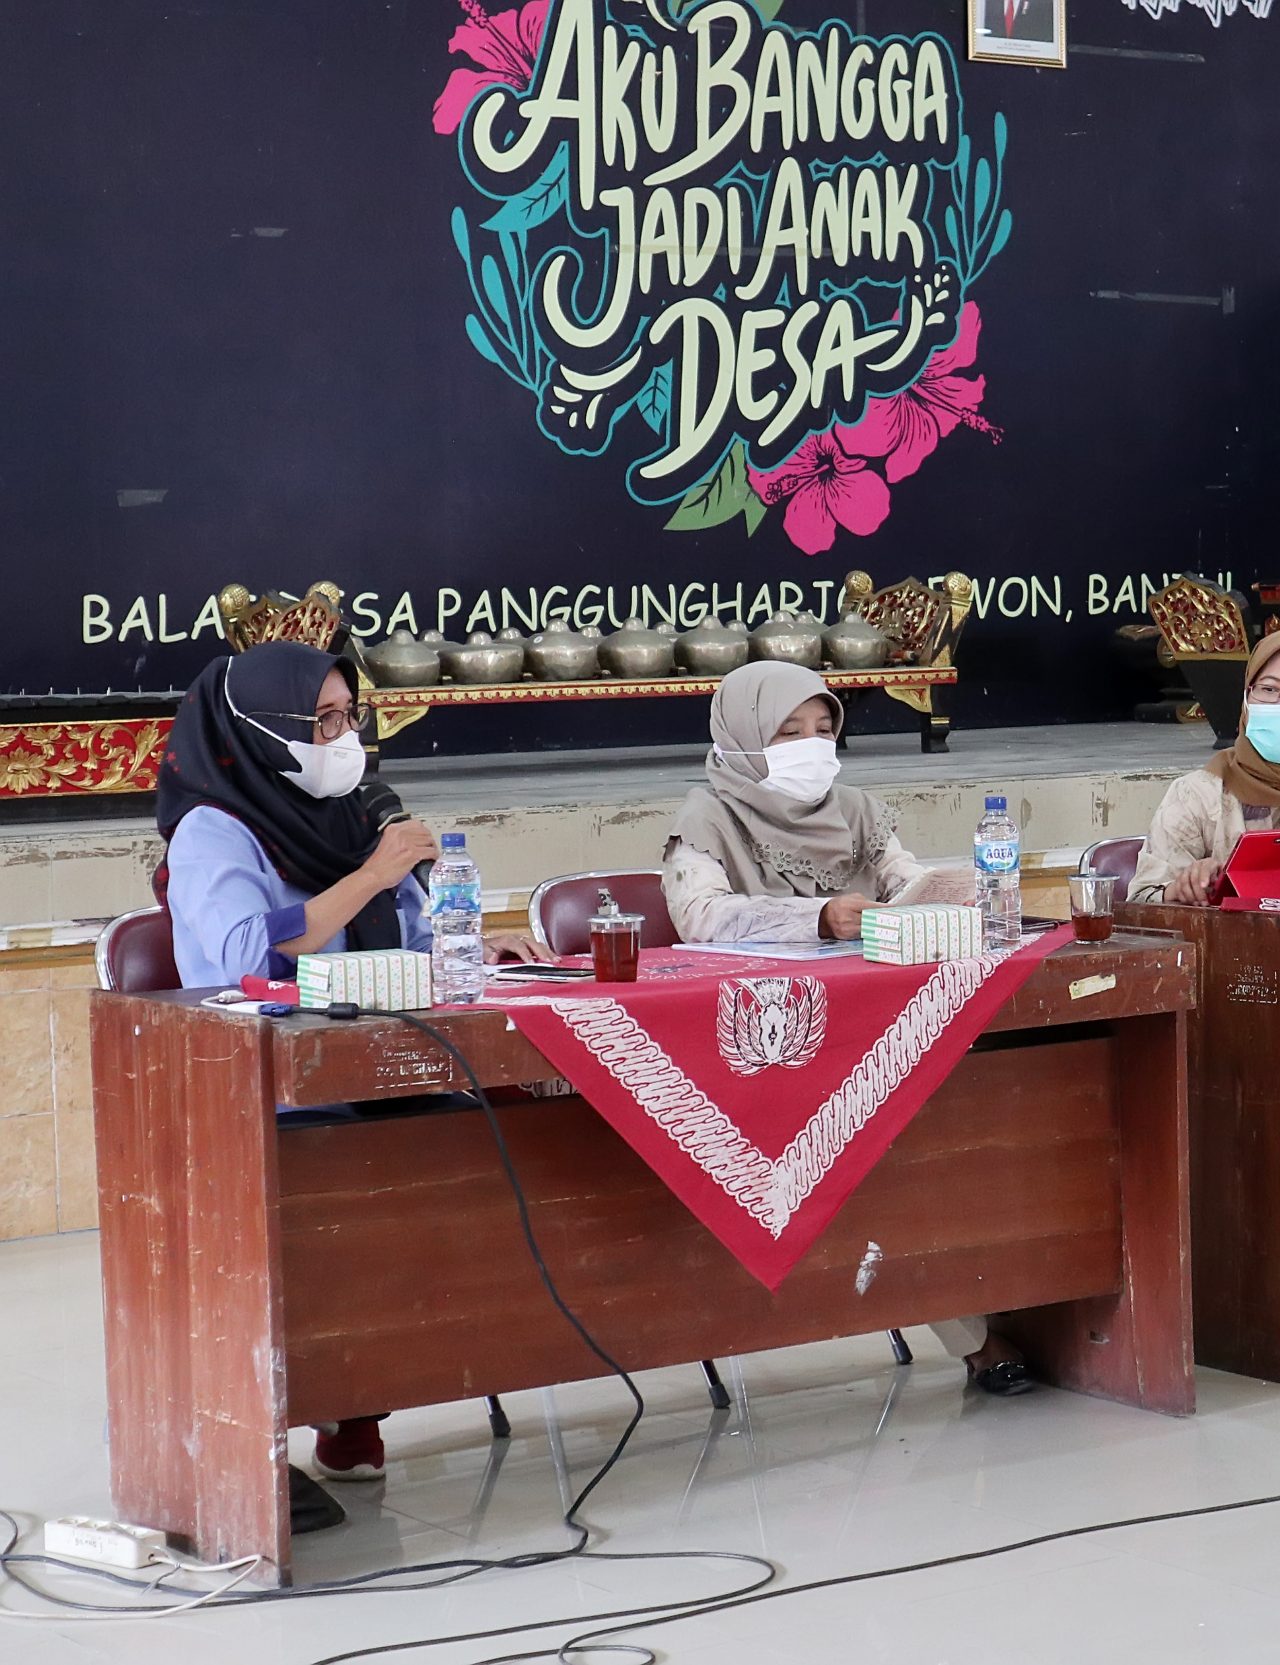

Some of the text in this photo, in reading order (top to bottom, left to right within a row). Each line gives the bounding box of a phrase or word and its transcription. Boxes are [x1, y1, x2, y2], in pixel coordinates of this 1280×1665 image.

[473, 0, 947, 210] AKU BANGGA
[543, 157, 924, 348] JADI ANAK
[640, 296, 900, 478] DESA
[82, 593, 256, 644] BALA
[438, 580, 847, 634] PANGGUNGHARJ
[986, 847, 1014, 861] AQUA
